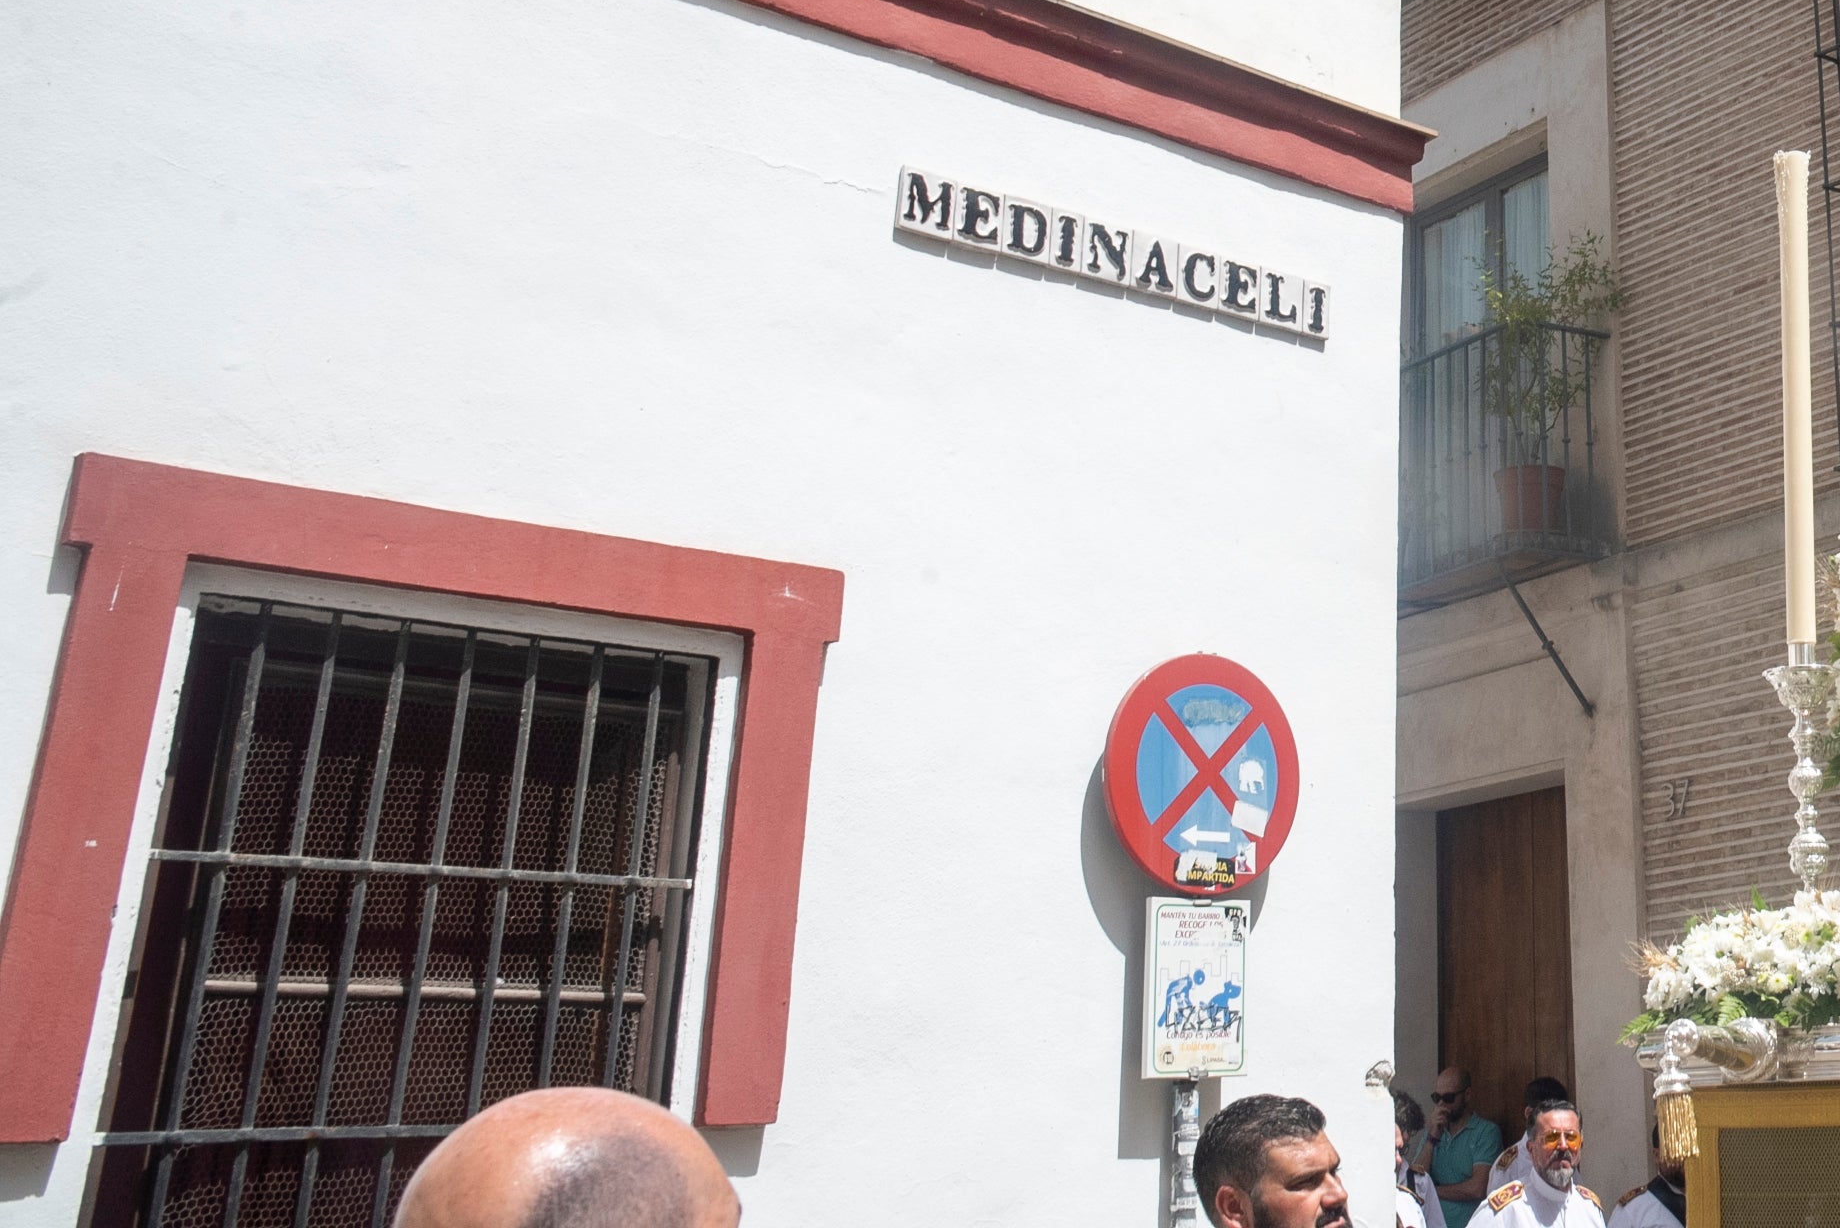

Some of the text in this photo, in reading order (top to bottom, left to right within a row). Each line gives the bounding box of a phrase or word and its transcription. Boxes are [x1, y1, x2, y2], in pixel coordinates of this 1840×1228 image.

[904, 172, 1326, 333] MEDINACELI
[1659, 779, 1689, 818] 37
[1175, 870, 1235, 884] MPARTIDA
